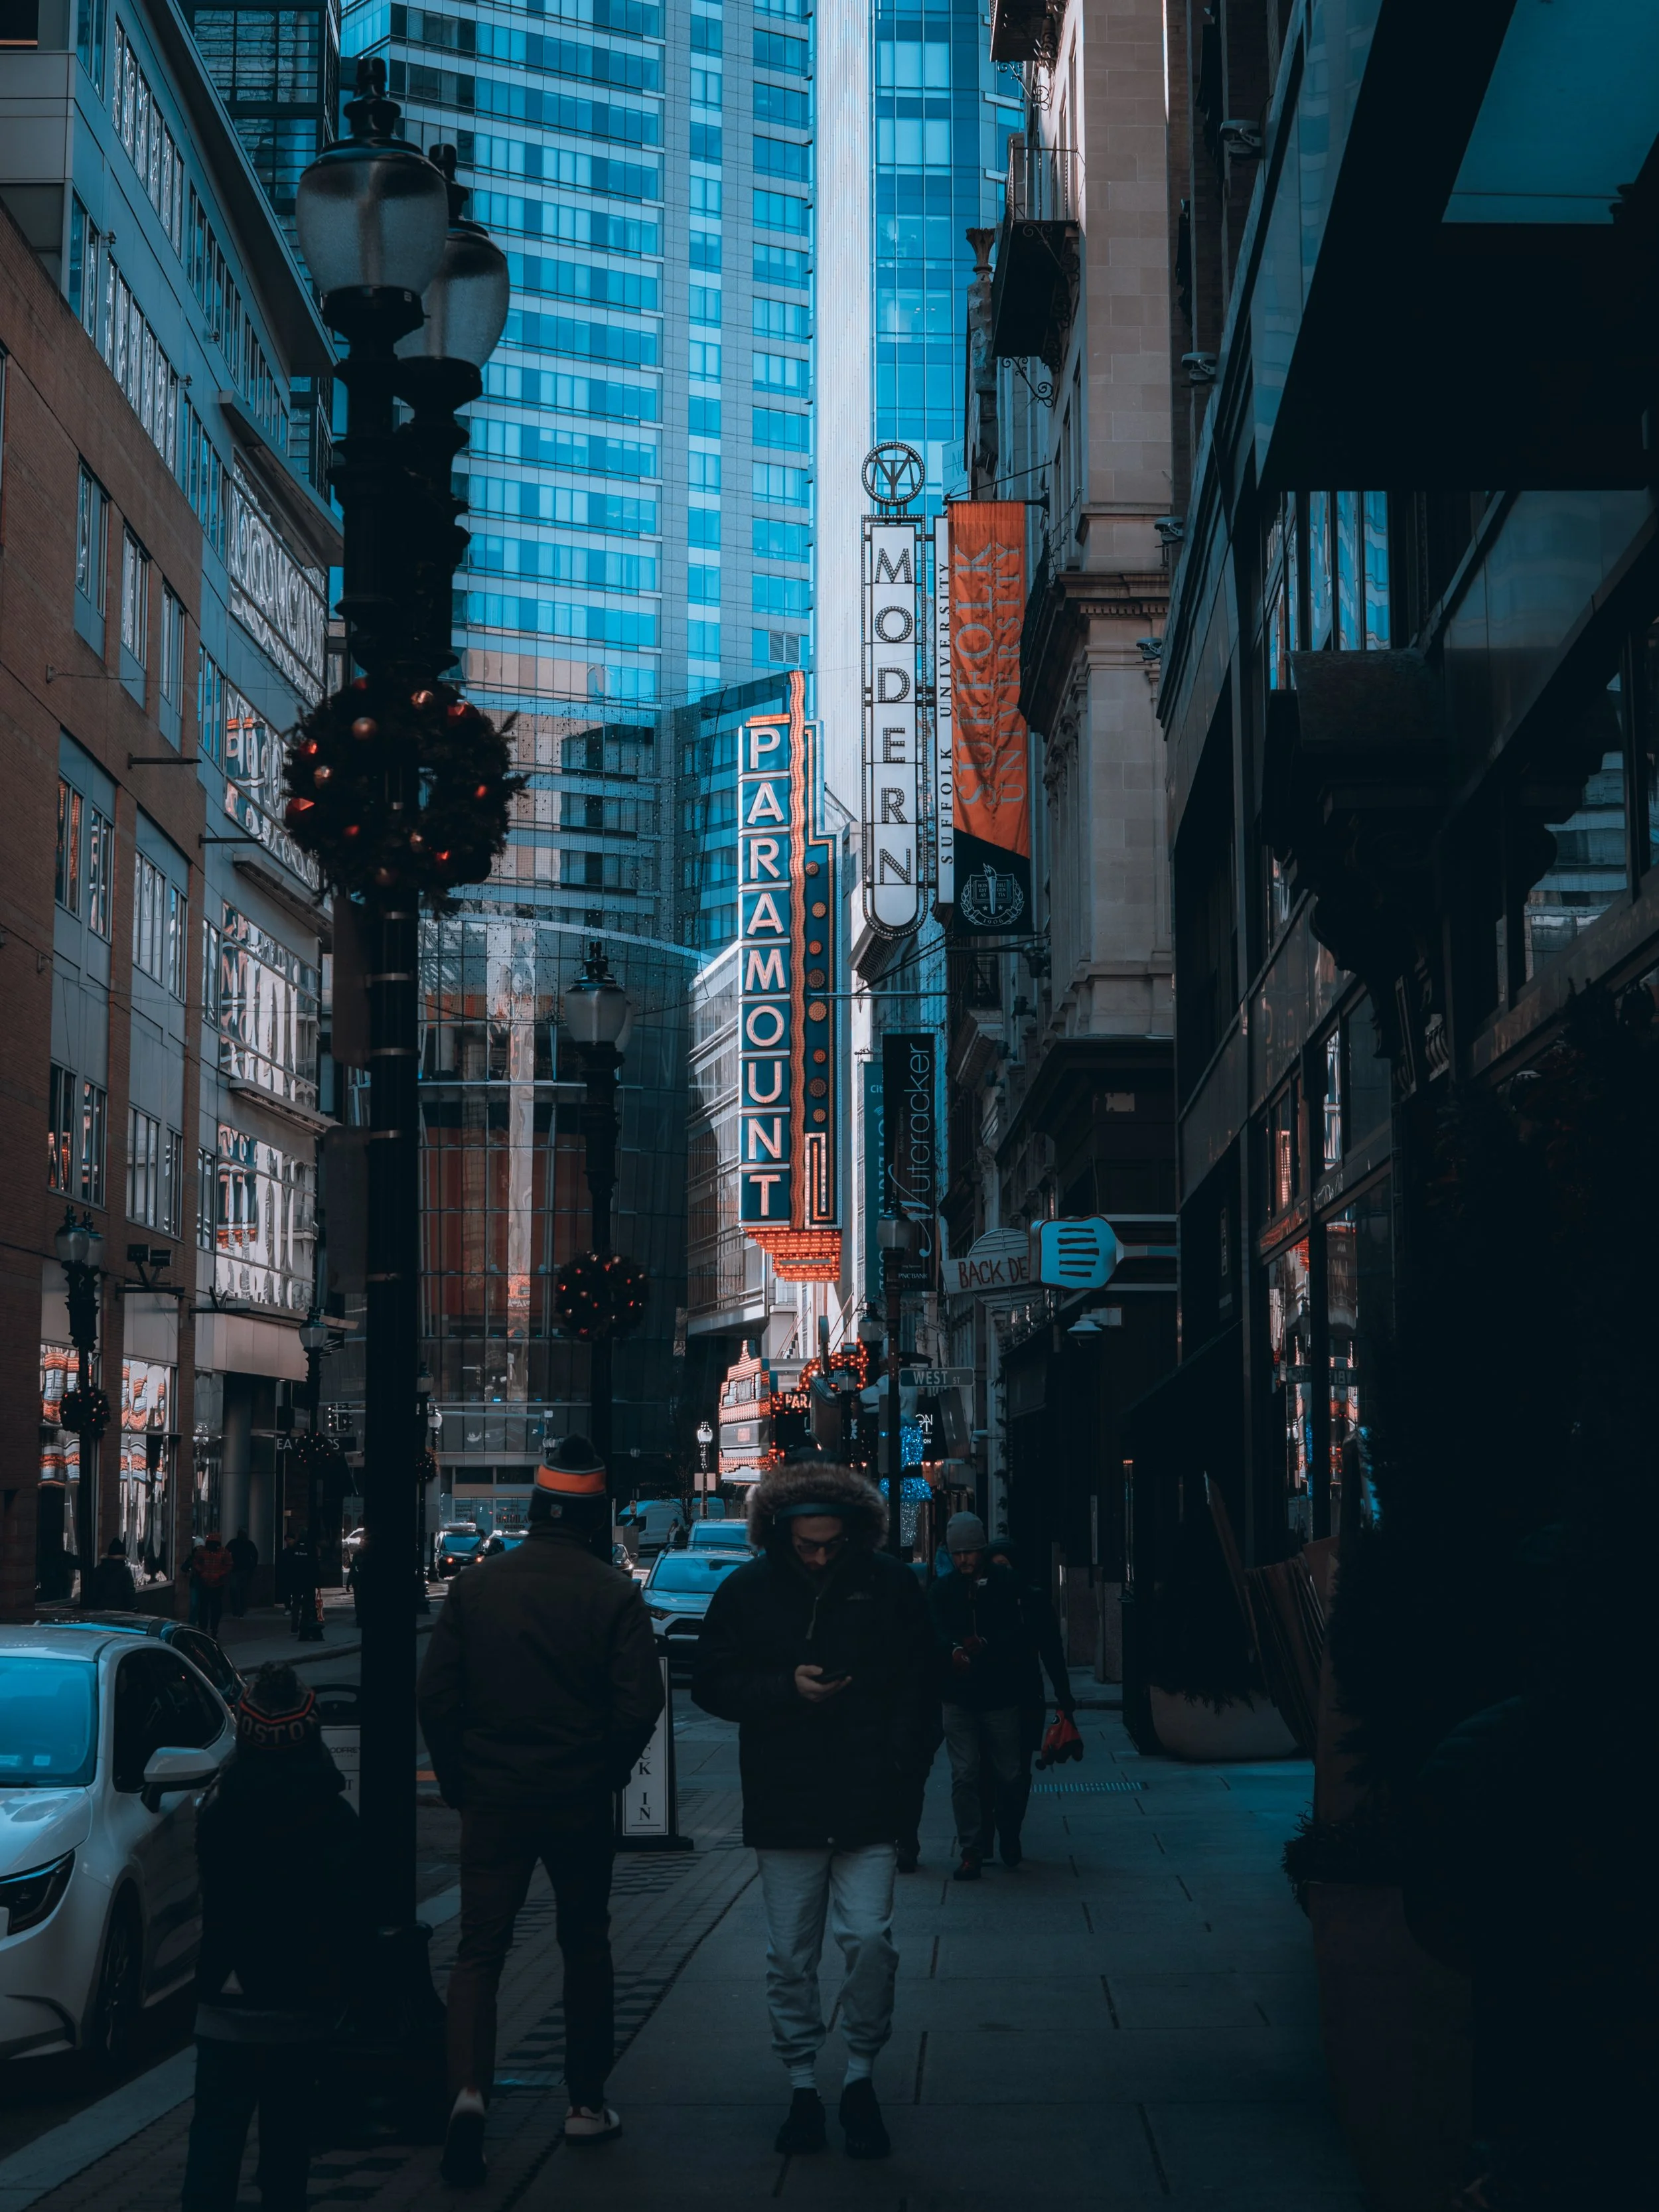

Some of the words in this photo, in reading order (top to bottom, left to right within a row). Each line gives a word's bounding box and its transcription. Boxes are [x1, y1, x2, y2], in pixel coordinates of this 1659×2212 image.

[875, 548, 912, 885] MODERN
[939, 563, 952, 718] UNIVERSITY
[954, 543, 995, 806] SUFFOLK
[995, 542, 1025, 806] UNIVERSITY
[940, 748, 953, 865] SUFFOLK
[745, 727, 786, 1217] PARAMOUNT
[887, 1042, 932, 1258] Nutcracker
[958, 1259, 1005, 1289] BACK
[913, 1370, 948, 1385] WEST
